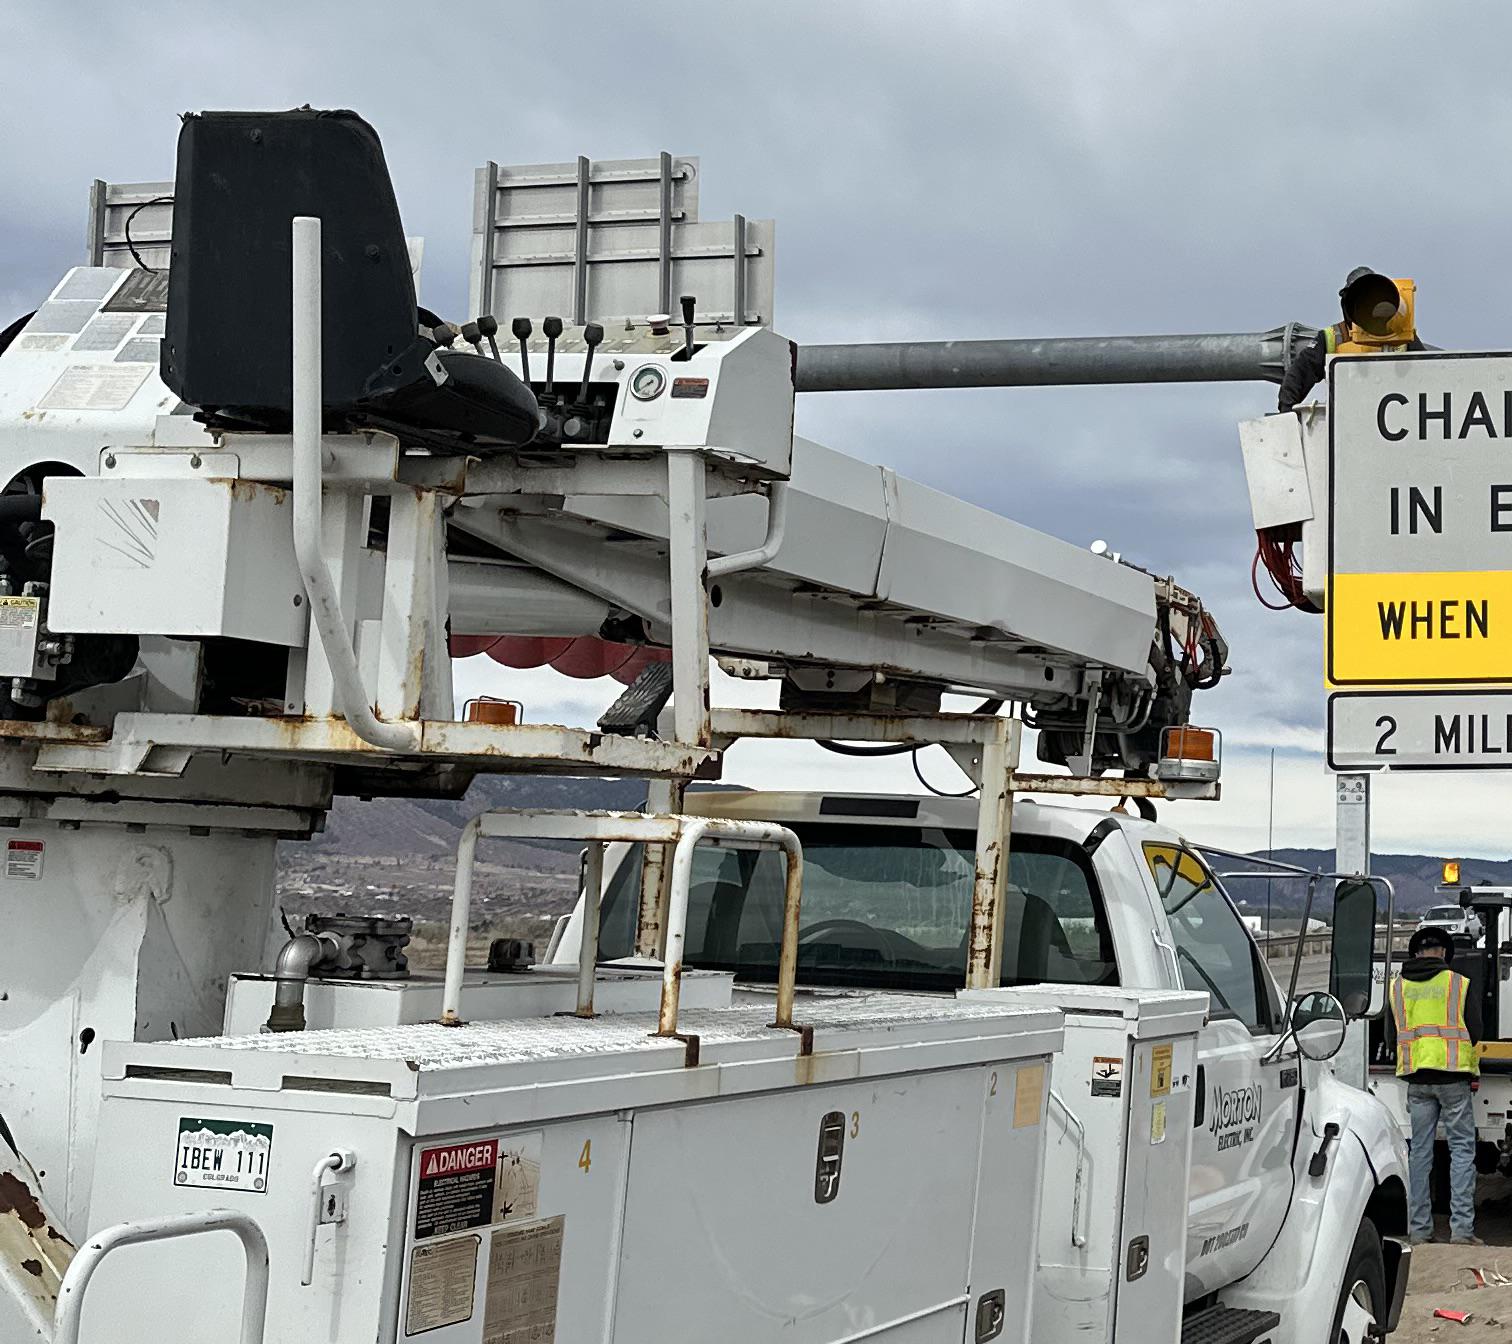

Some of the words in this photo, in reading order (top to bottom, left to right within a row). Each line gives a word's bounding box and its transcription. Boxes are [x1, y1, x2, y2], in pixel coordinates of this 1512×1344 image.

[1389, 485, 1444, 536] IN
[1377, 599, 1489, 642] WHEN
[1374, 715, 1398, 756] 2
[989, 1071, 998, 1097] 2
[850, 1110, 860, 1139] 3
[1209, 1083, 1262, 1136] MORTON
[181, 1145, 224, 1171] IBEW
[237, 1150, 265, 1175] 111
[439, 1144, 492, 1173] DANGER
[578, 1138, 592, 1174] 4
[202, 1173, 239, 1183] COLORADO
